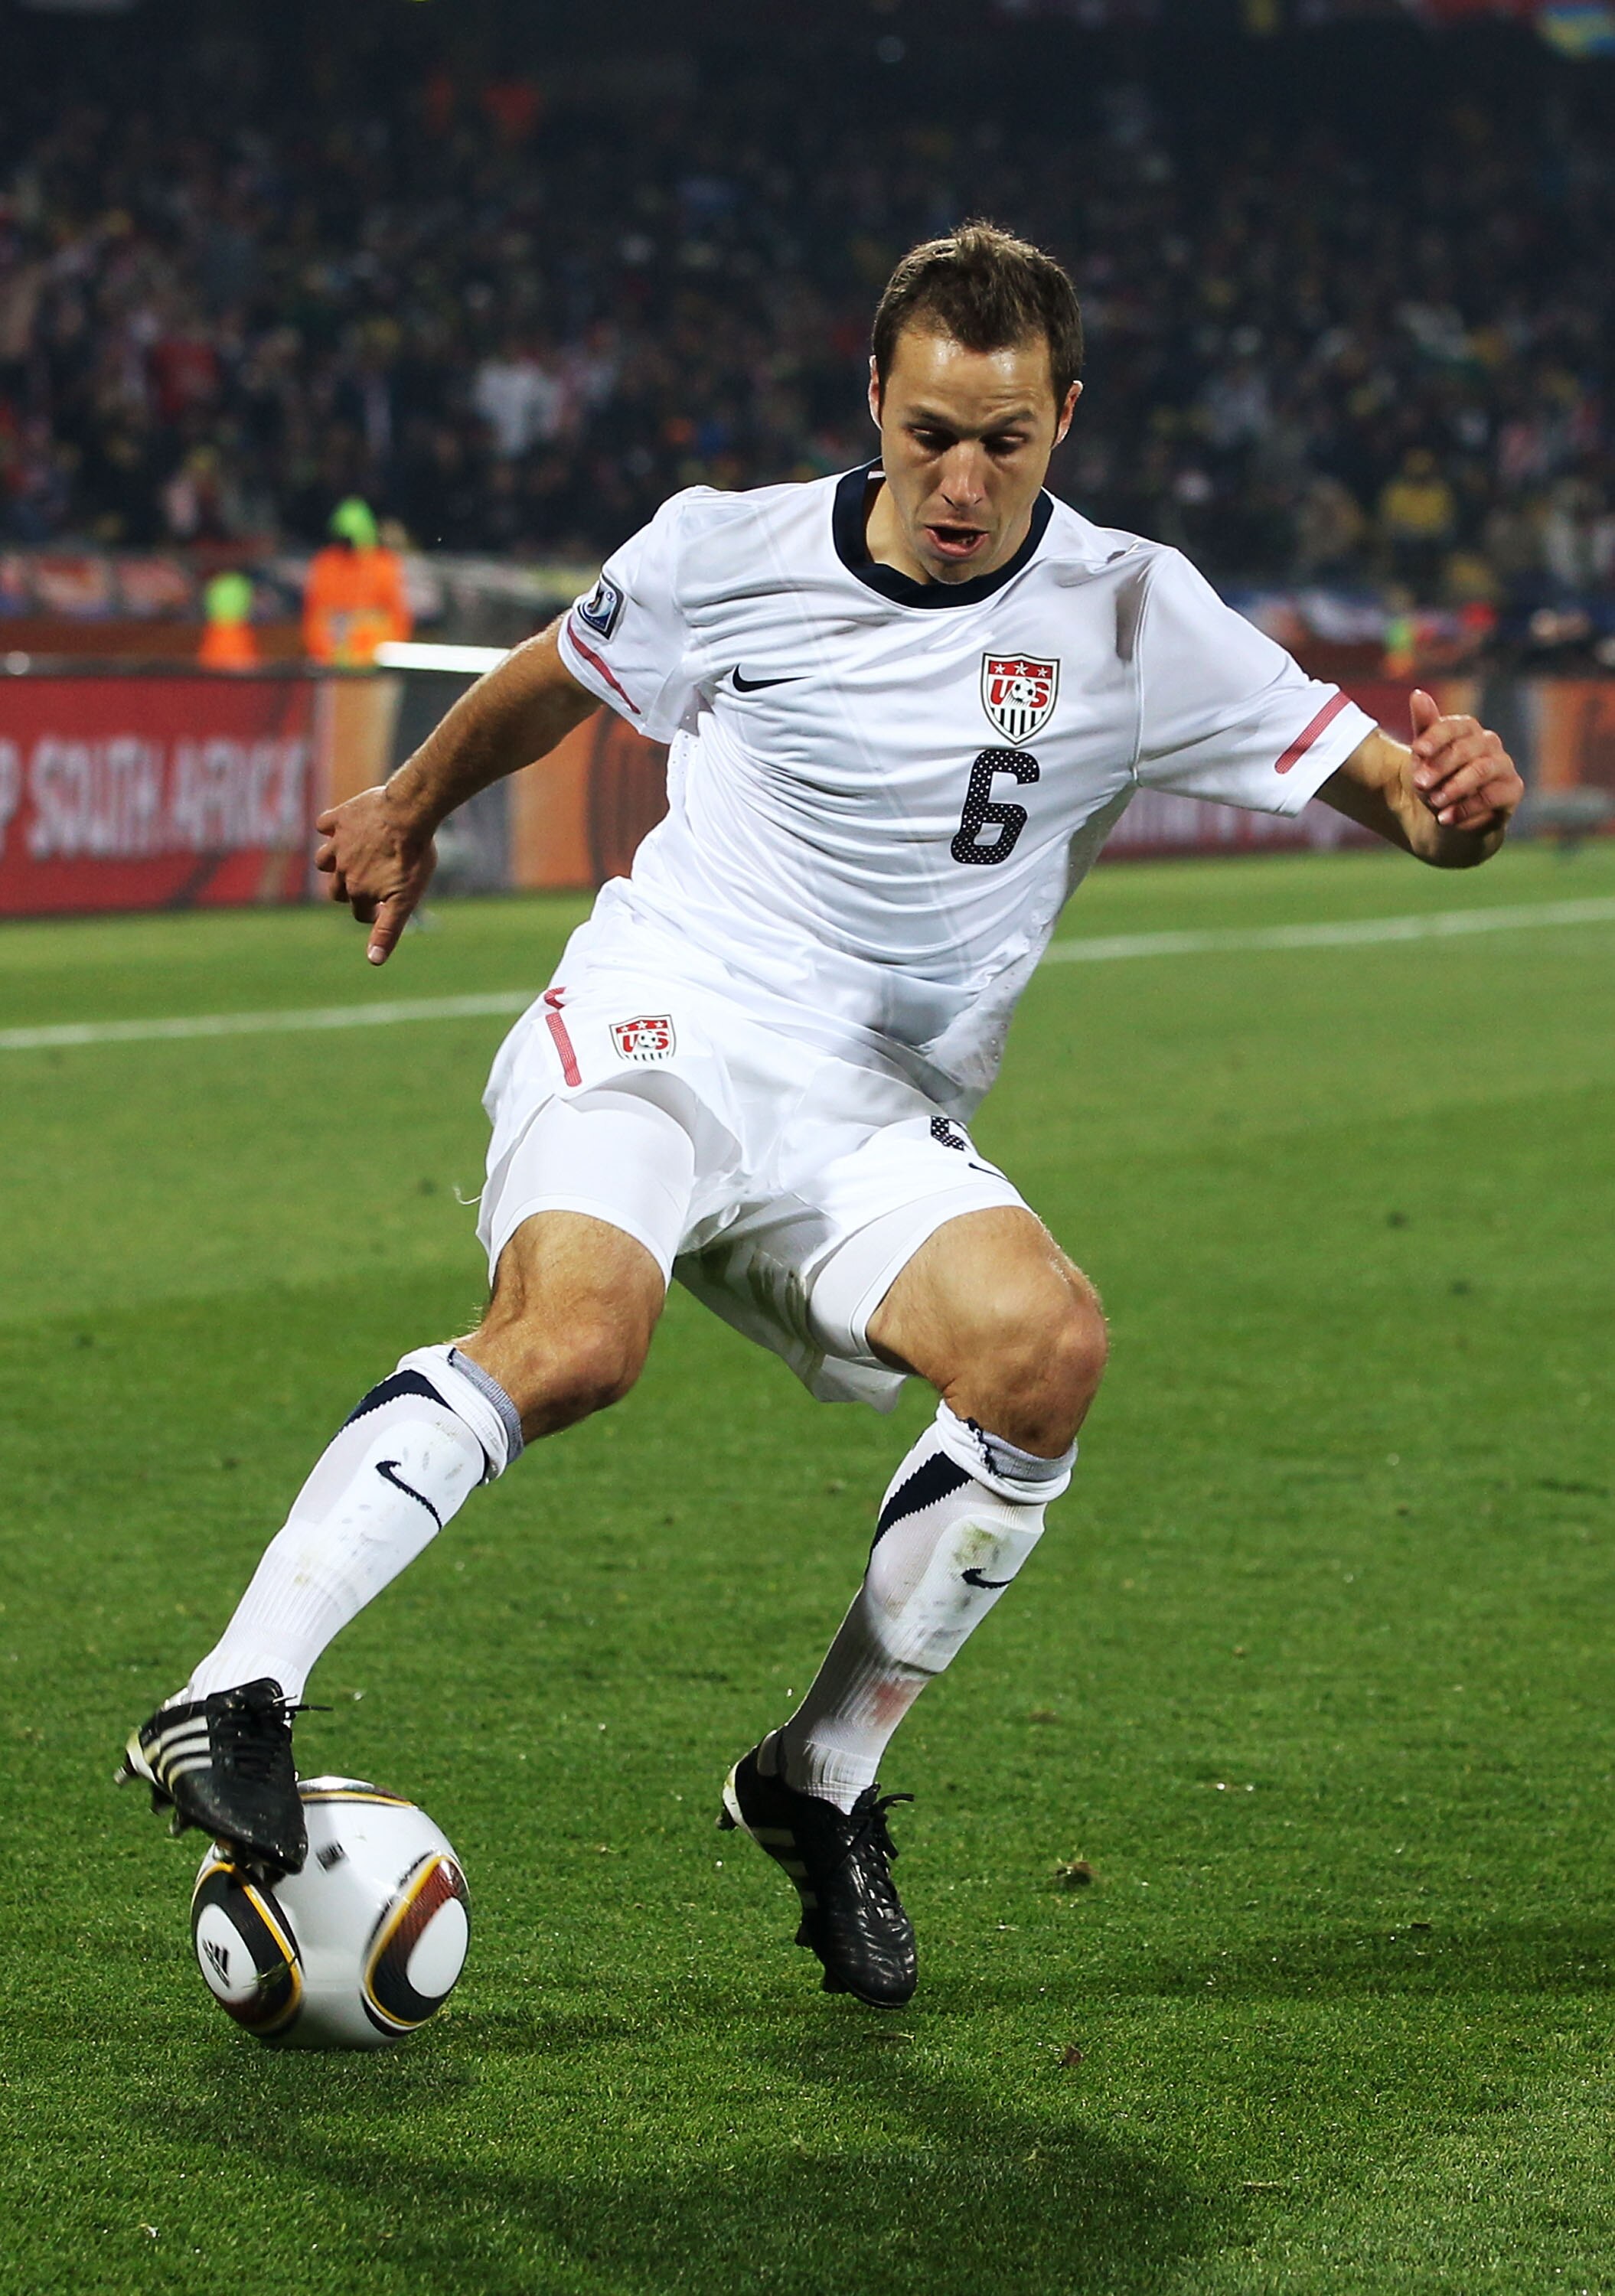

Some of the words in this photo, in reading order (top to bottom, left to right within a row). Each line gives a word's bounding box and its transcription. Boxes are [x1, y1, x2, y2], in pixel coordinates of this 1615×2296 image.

[28, 735, 162, 860] SOUTH
[171, 735, 309, 851] AFRICA
[951, 748, 1040, 865] 6
